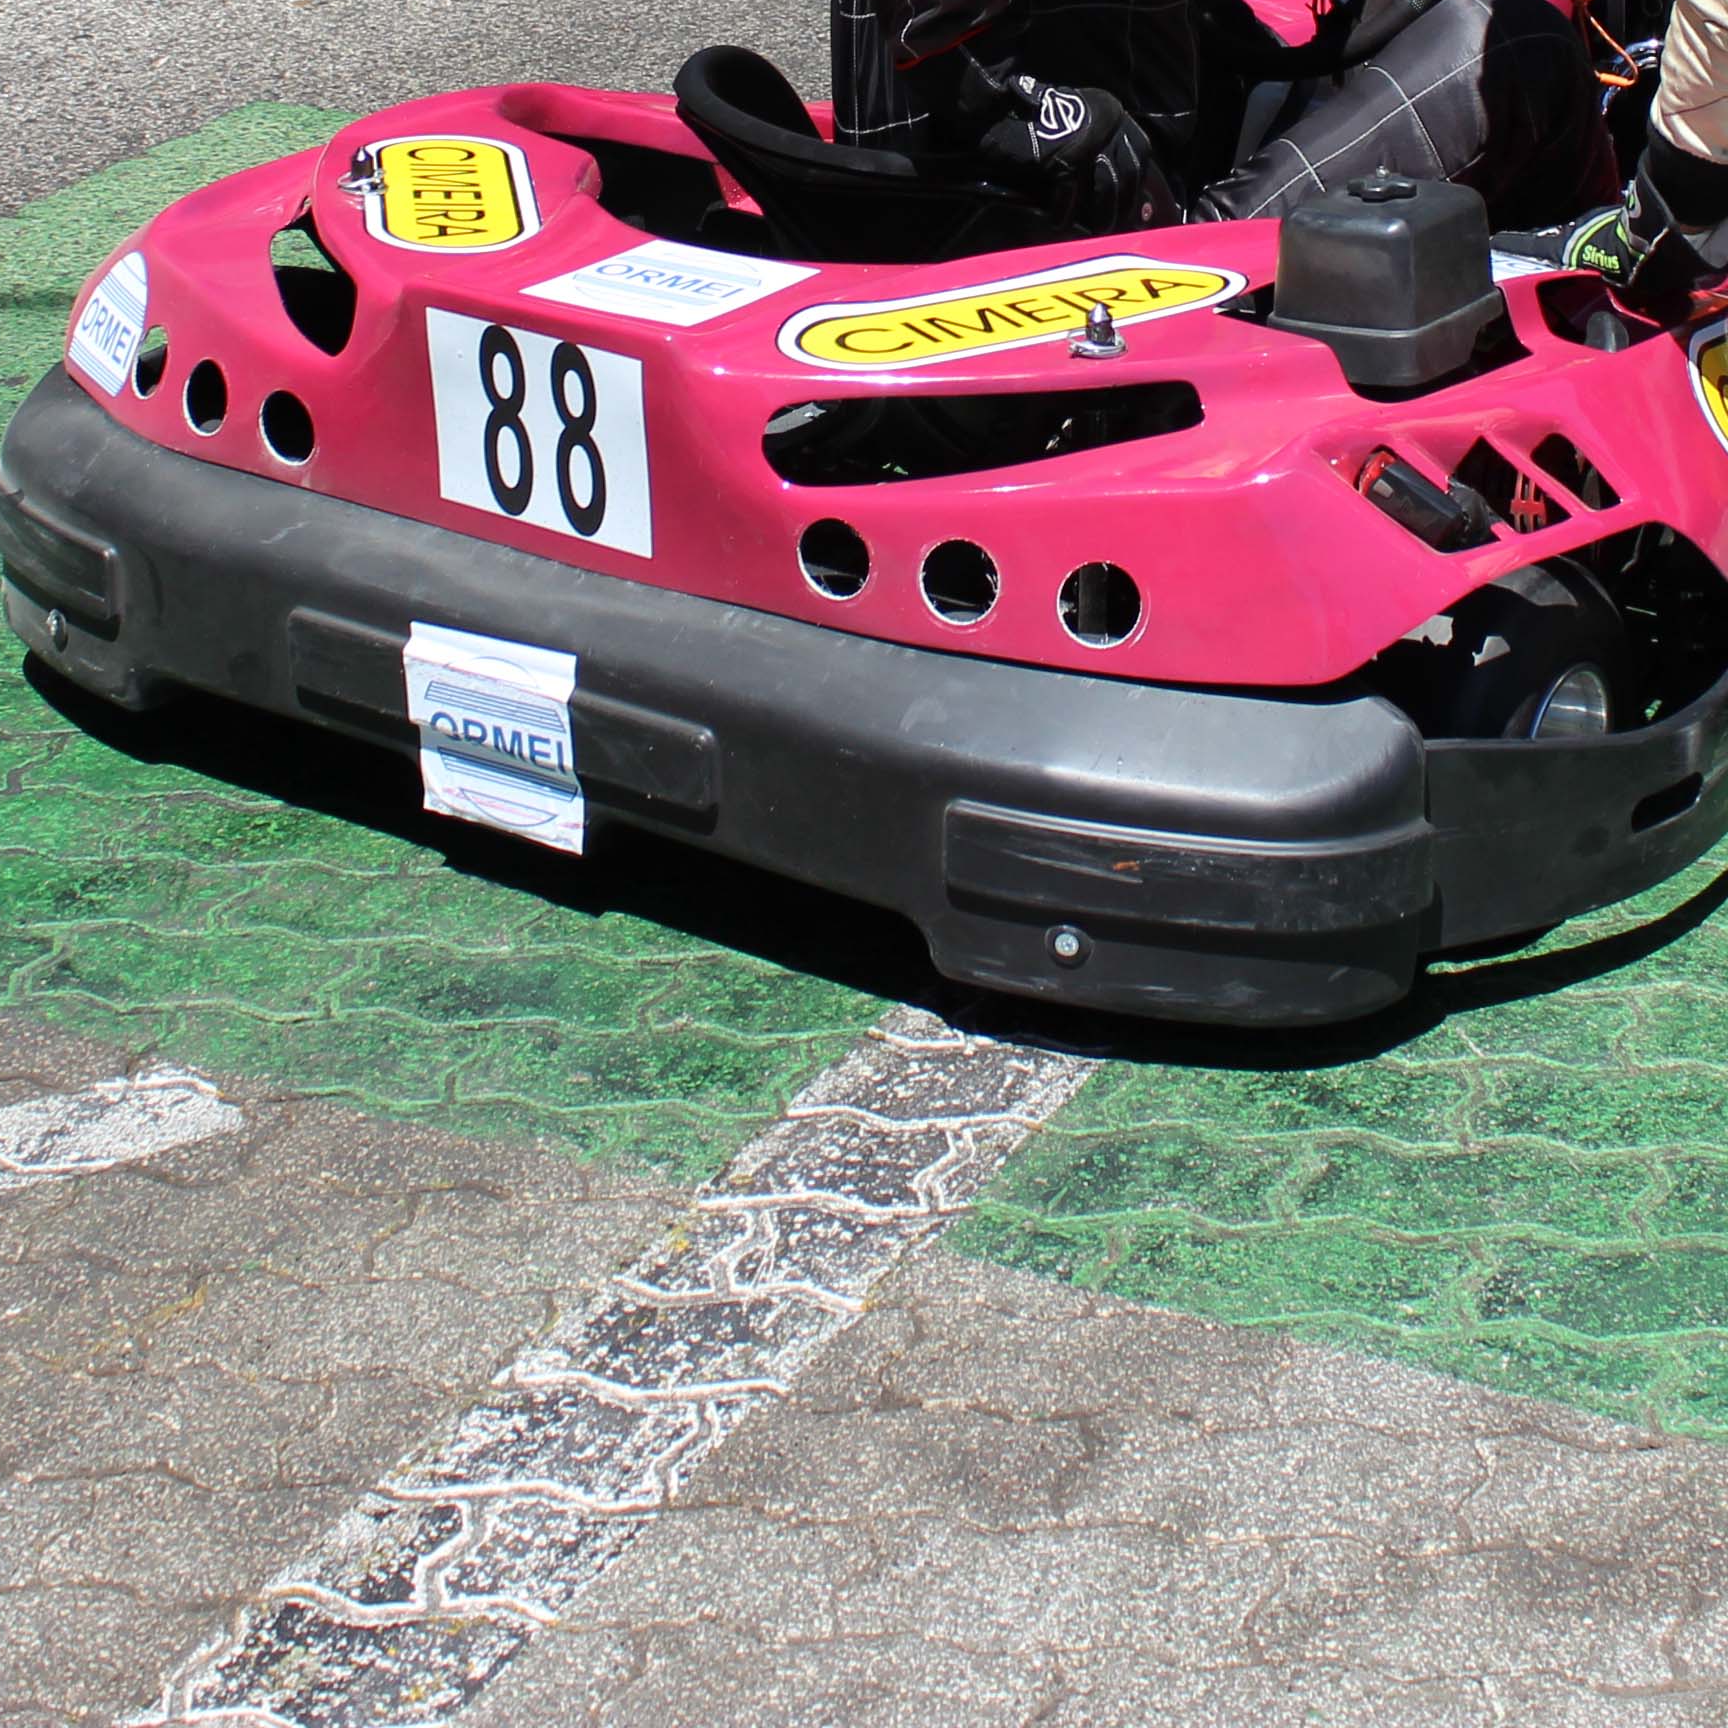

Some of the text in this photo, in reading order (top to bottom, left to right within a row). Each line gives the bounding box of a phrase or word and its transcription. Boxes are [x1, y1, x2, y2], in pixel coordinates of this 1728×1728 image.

[408, 146, 489, 241] CIMEIRA
[595, 262, 744, 300] ORMEI
[1583, 245, 1619, 270] Sirius
[82, 298, 137, 370] ORMEI
[834, 276, 1206, 355] CIMEIRA
[479, 324, 606, 536] 88
